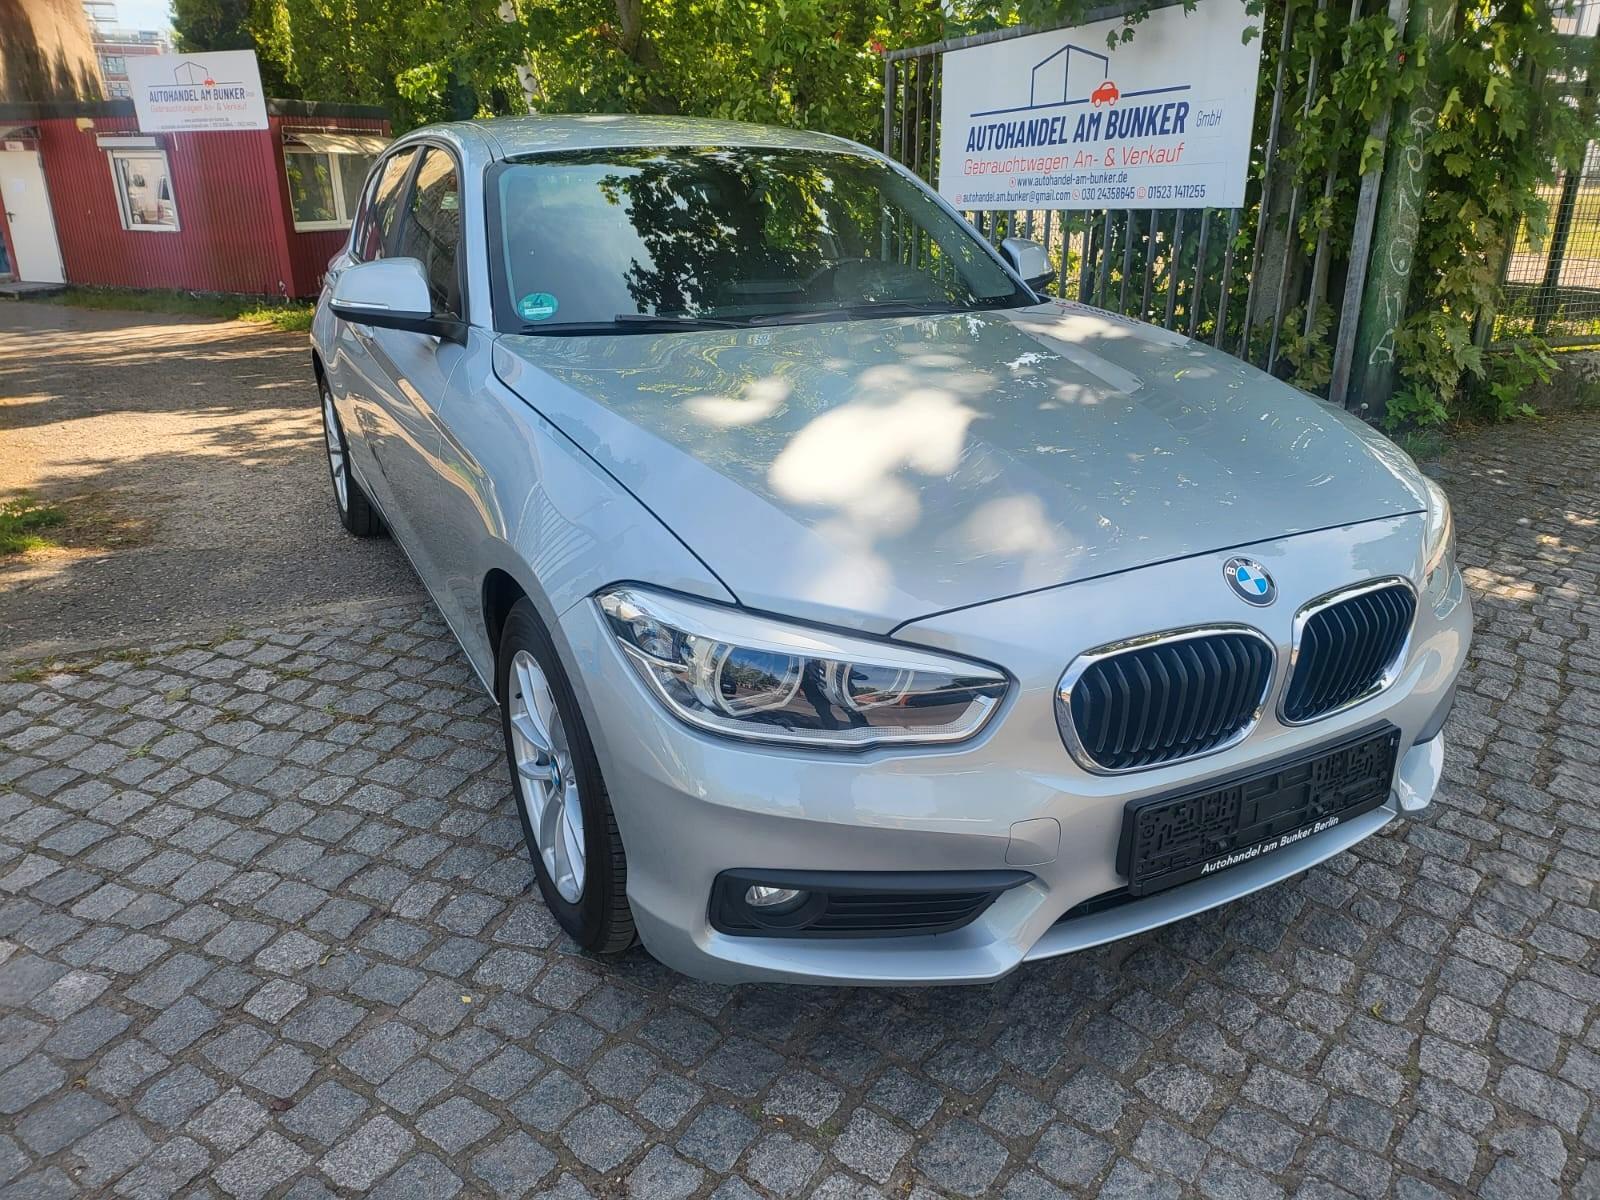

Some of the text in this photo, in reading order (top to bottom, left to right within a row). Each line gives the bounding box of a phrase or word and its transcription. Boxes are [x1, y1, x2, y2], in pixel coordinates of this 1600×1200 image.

[149, 89, 199, 103] AUTOHANDEL
[200, 88, 212, 101] AM
[213, 87, 246, 101] BUNKER
[966, 101, 1223, 152] AUTOHANDEL AM BUNKER GmbH
[964, 142, 1185, 175] Gebrauchtwagen An- & Verkauf
[1017, 171, 1128, 187] www.autohandel-am-bunker.de
[963, 184, 1206, 203] autohandel.am.bunker@gmail.com 030 24358645 01523 1411255
[1201, 816, 1339, 874] Autohandel am Bunker Berlin
